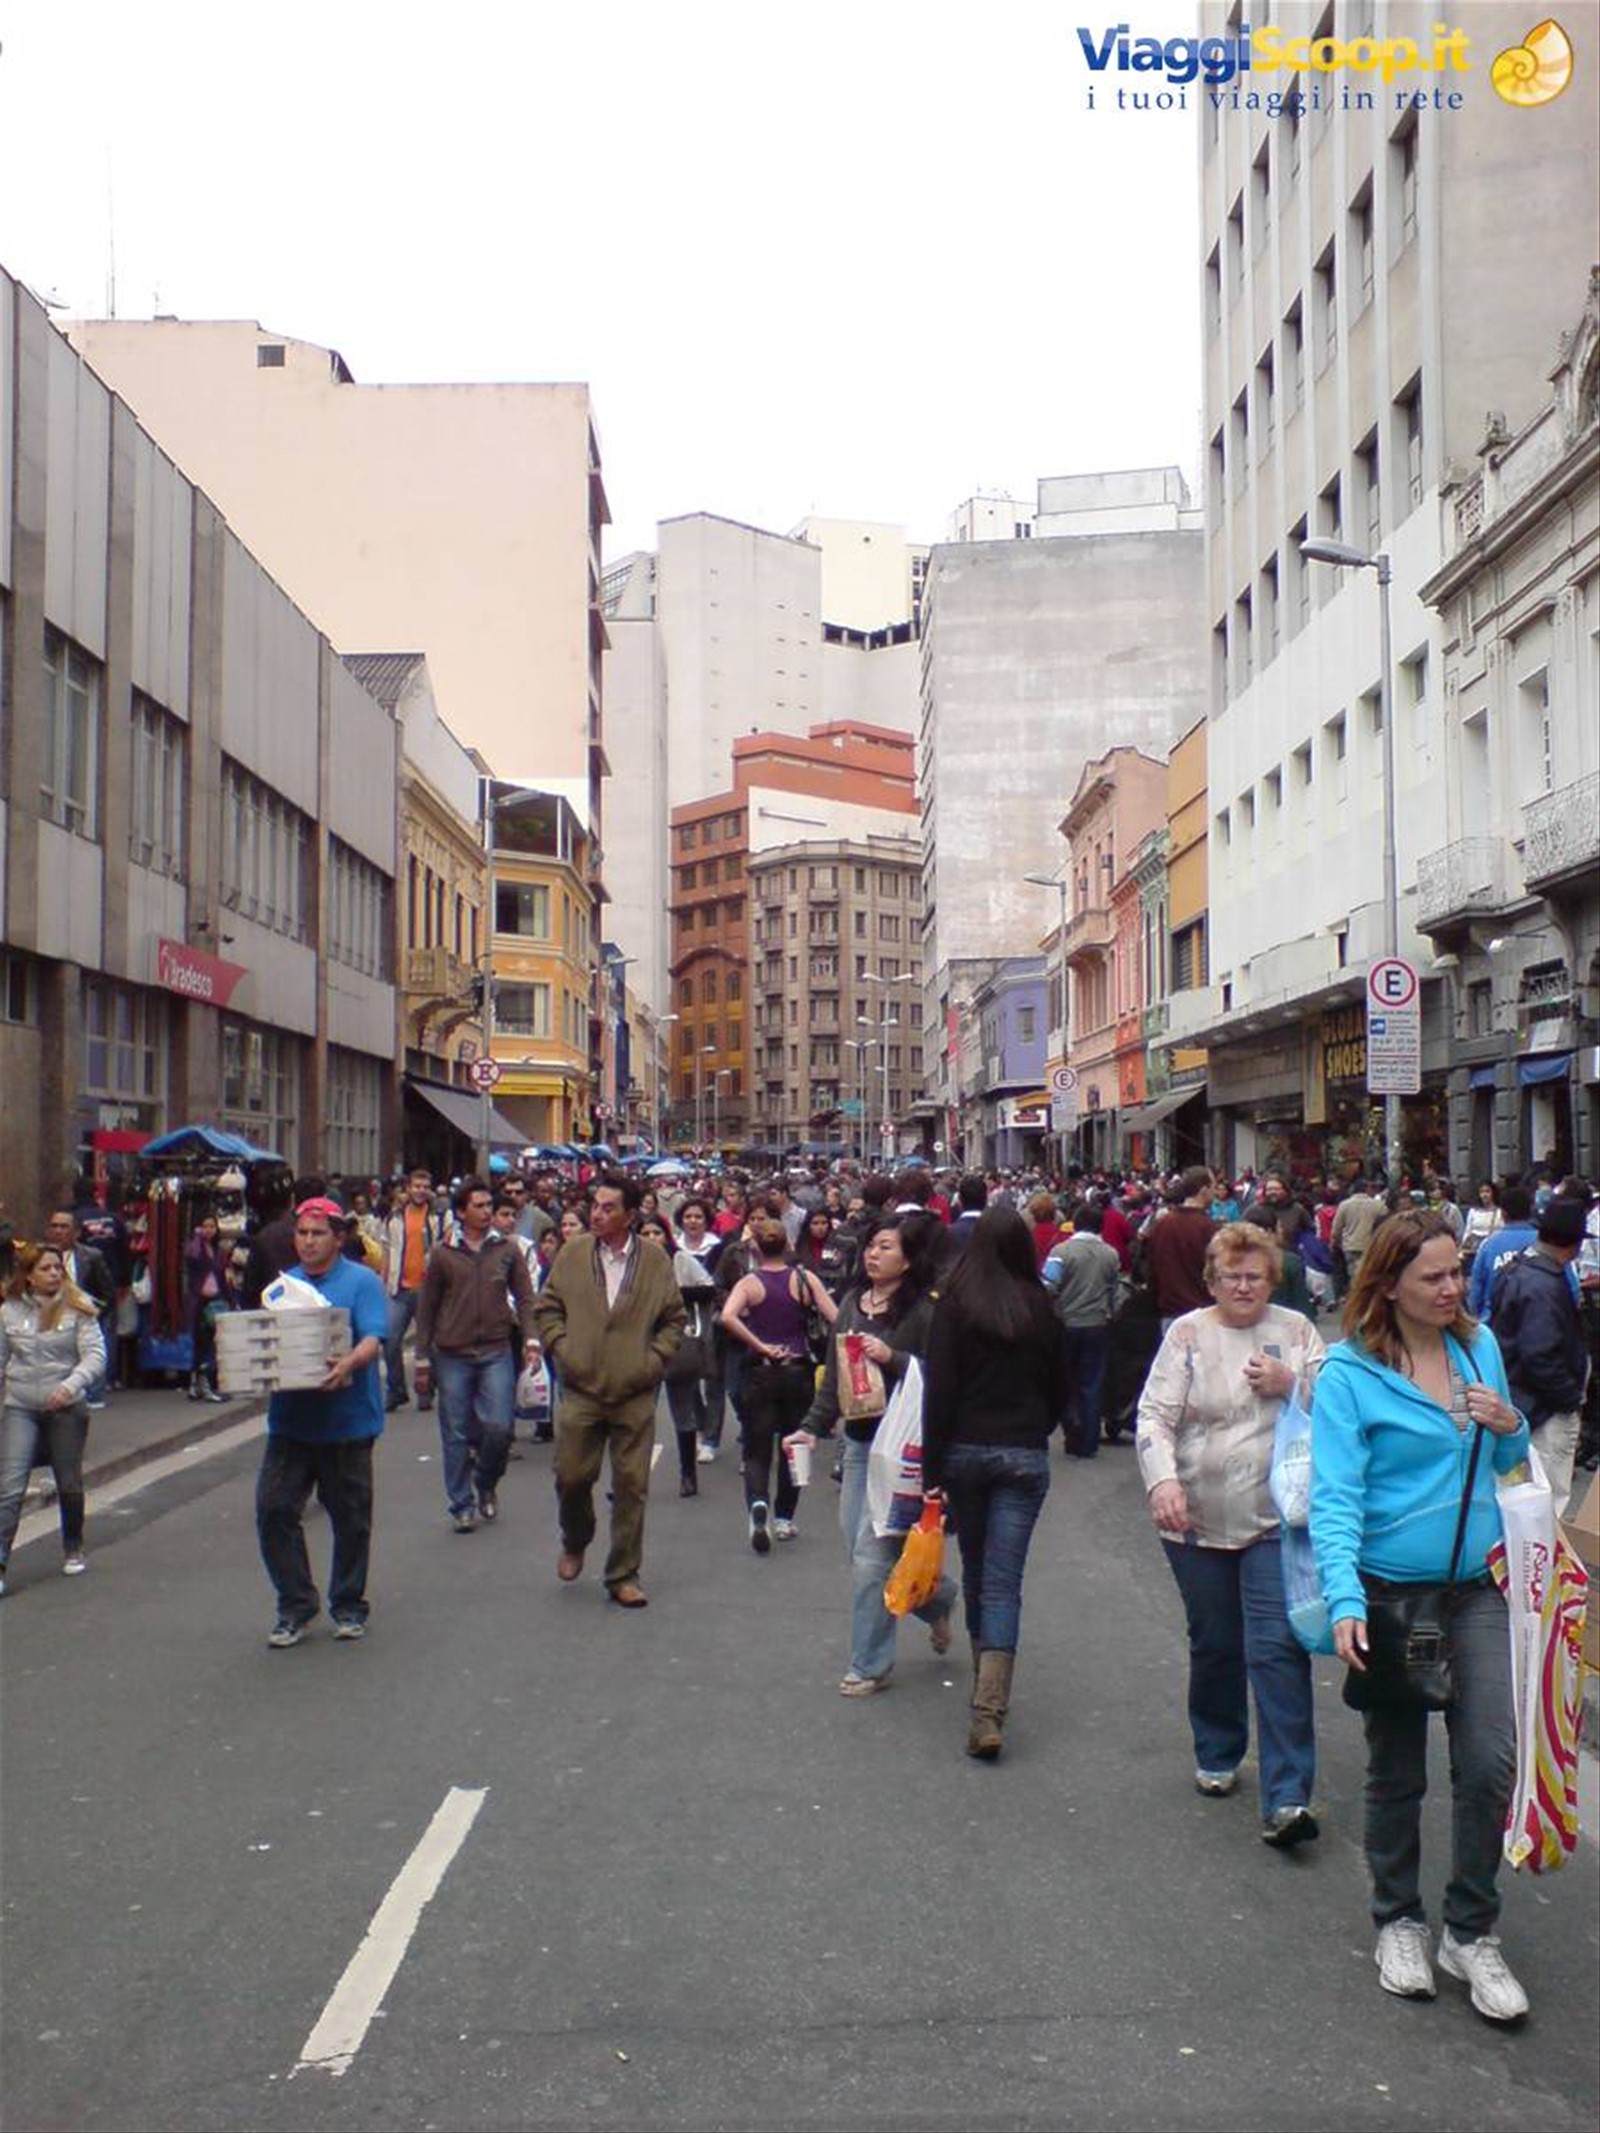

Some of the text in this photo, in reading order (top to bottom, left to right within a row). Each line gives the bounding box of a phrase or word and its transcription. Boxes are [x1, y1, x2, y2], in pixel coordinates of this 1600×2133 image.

[170, 957, 213, 998] Bradesco
[1385, 970, 1402, 995] E
[1326, 1040, 1366, 1080] SHOES
[1059, 1073, 1069, 1086] E
